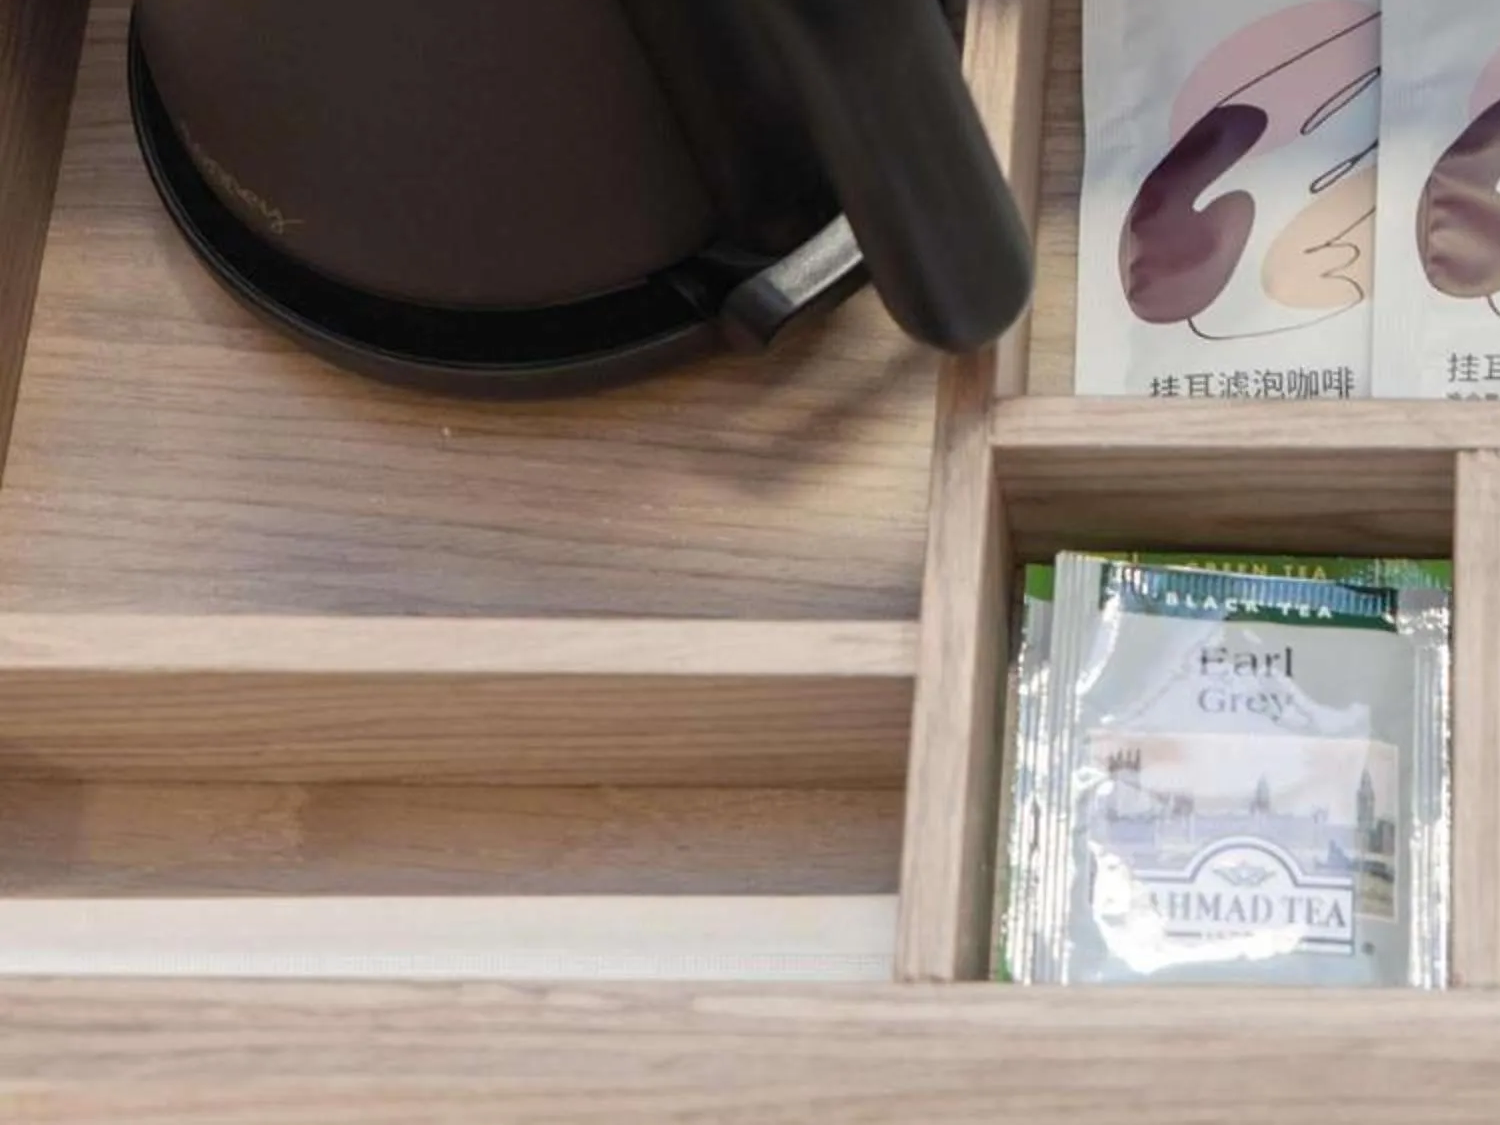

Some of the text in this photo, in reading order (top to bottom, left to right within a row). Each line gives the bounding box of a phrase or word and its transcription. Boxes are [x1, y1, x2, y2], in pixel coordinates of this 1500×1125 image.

[1149, 366, 1357, 399] 挂耳滤泡咖啡
[1165, 590, 1333, 620] BLACK TEA
[1200, 646, 1294, 677] Earl
[1197, 687, 1294, 722] Grey
[1280, 895, 1347, 929] TEA
